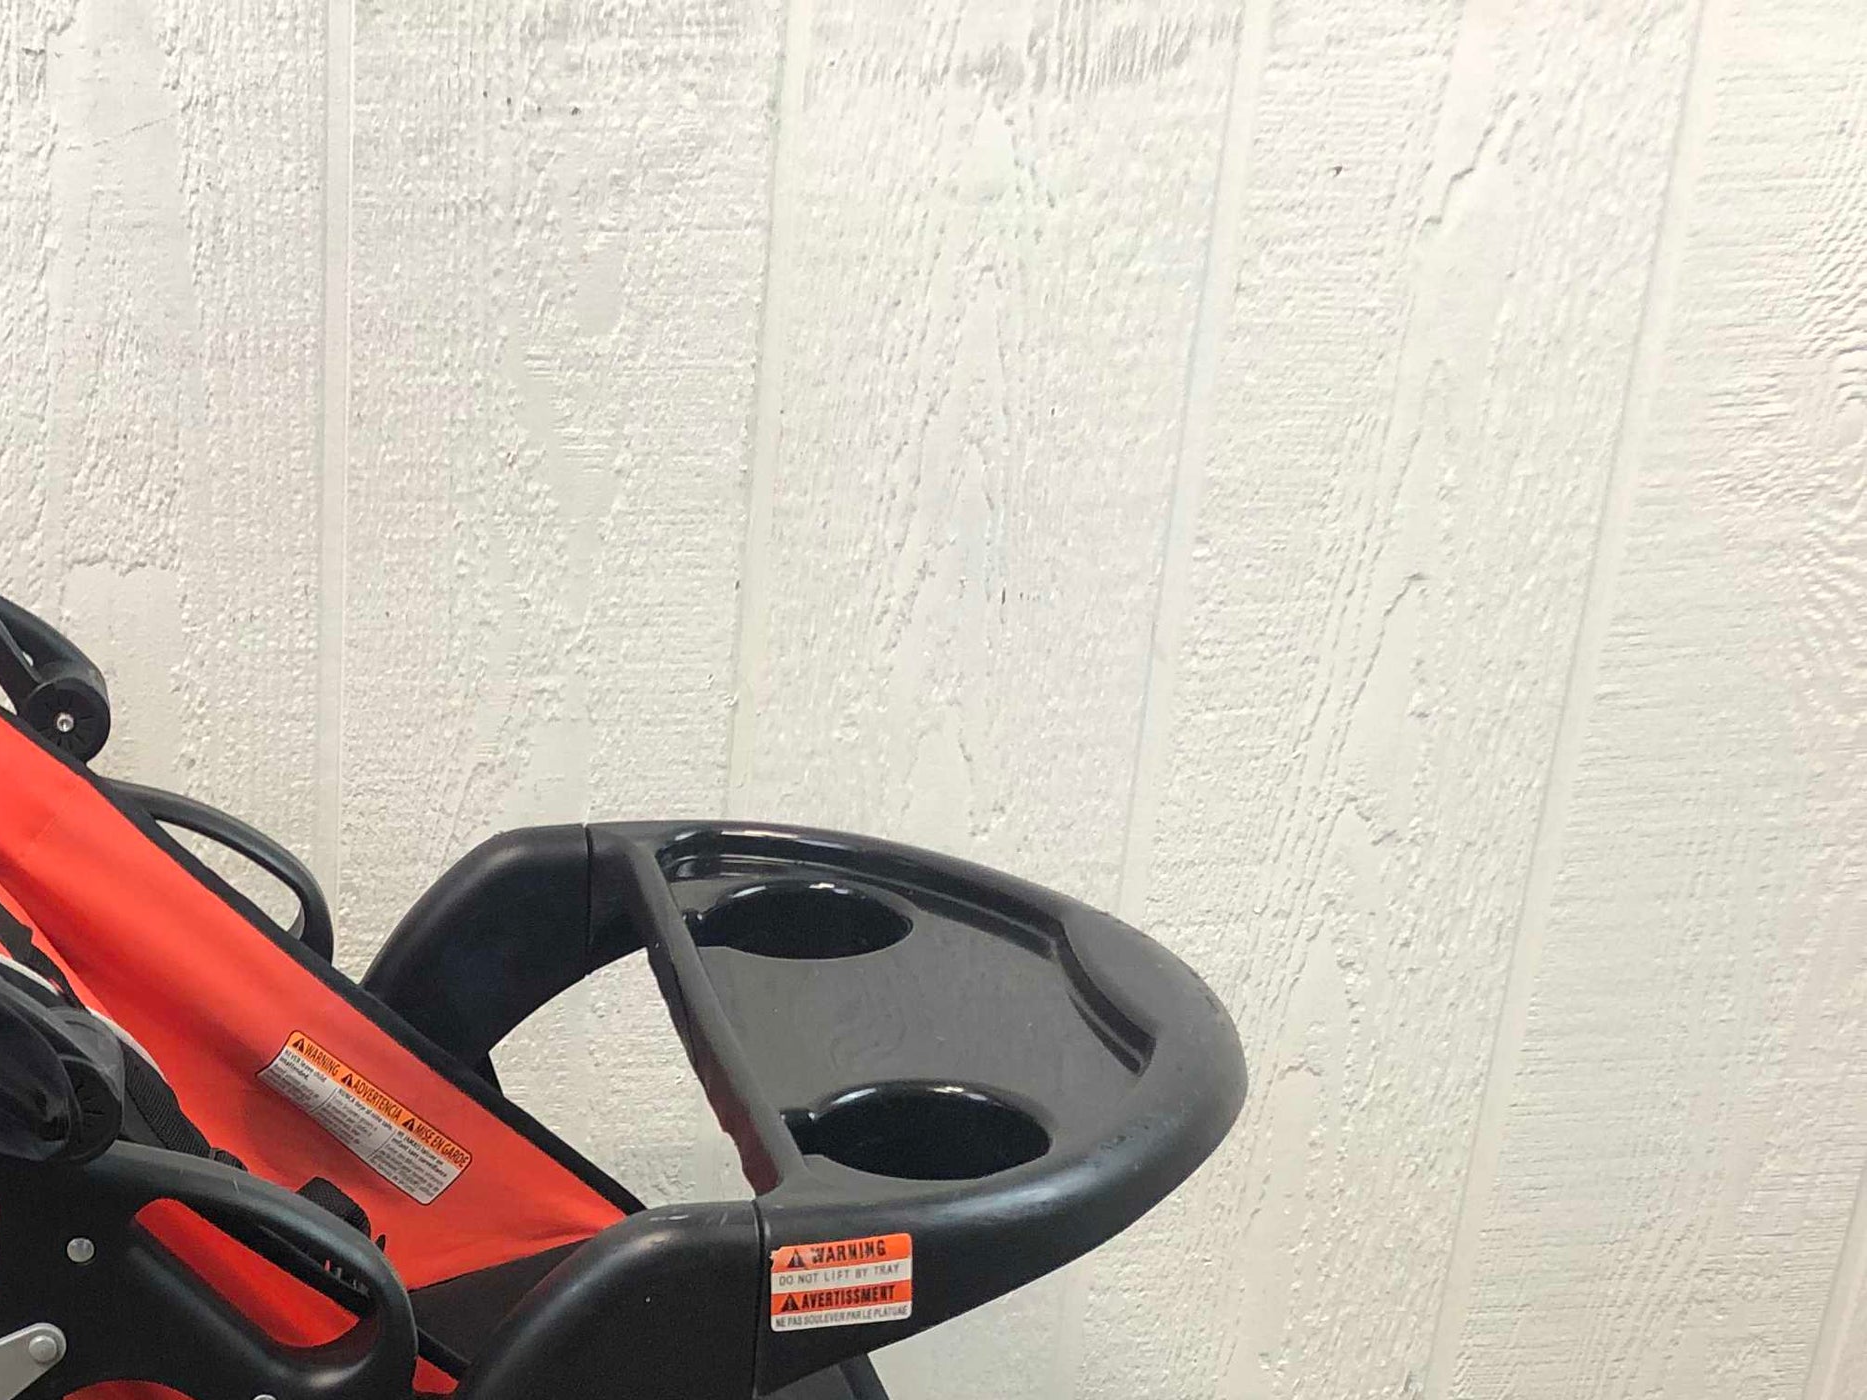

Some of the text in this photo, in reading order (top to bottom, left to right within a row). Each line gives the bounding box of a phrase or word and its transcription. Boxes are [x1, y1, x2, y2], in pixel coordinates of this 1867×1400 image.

[304, 1043, 341, 1077] WARNING
[353, 1079, 403, 1121] ADVERTENCIA
[414, 1122, 470, 1169] MISE EN GARDE
[811, 1239, 886, 1264] WARNING
[779, 1263, 900, 1287] DO NOT LIFT BY TRAY
[801, 1285, 895, 1309] AVERTISSMENT
[787, 1313, 803, 1327] PAS
